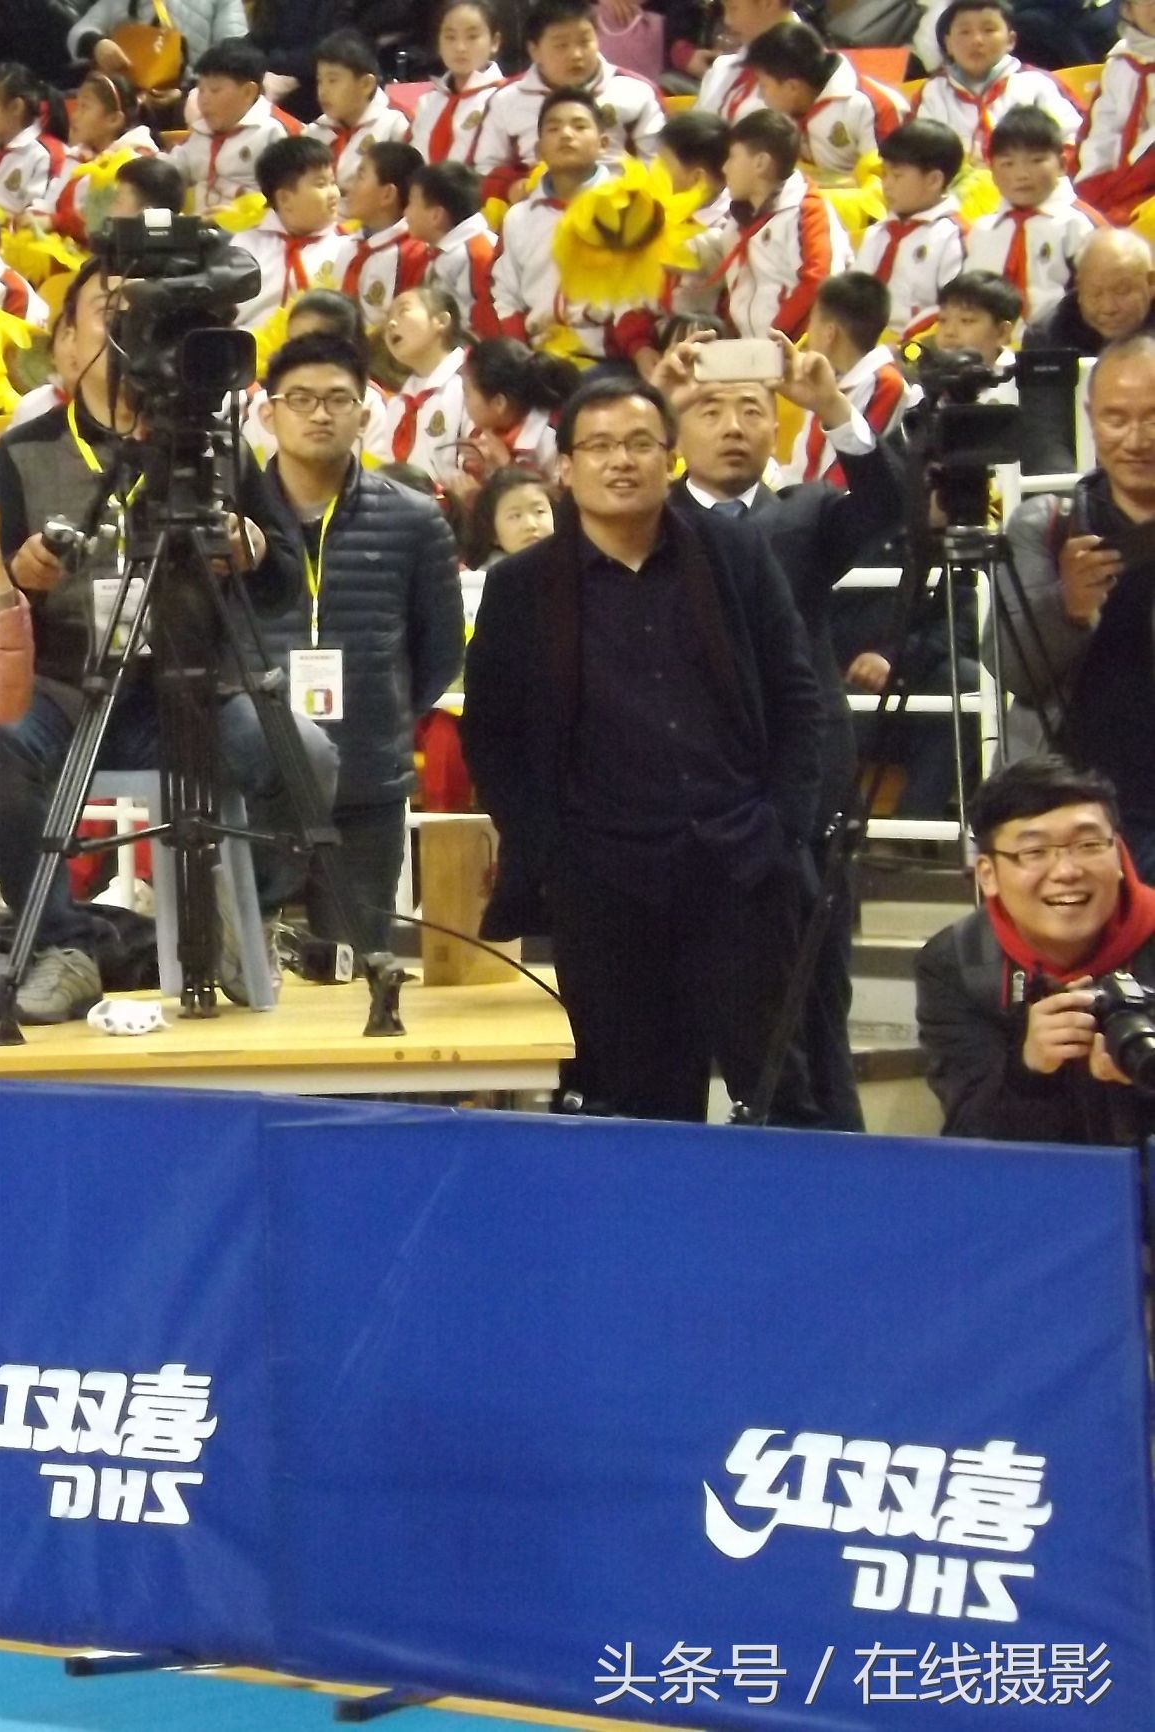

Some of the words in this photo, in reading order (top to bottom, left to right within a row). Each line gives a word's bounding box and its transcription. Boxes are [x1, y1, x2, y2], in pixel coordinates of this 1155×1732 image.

[39, 1463, 205, 1525] DHS
[703, 1428, 1053, 1559] 红双喜
[842, 1546, 1035, 1623] DHS
